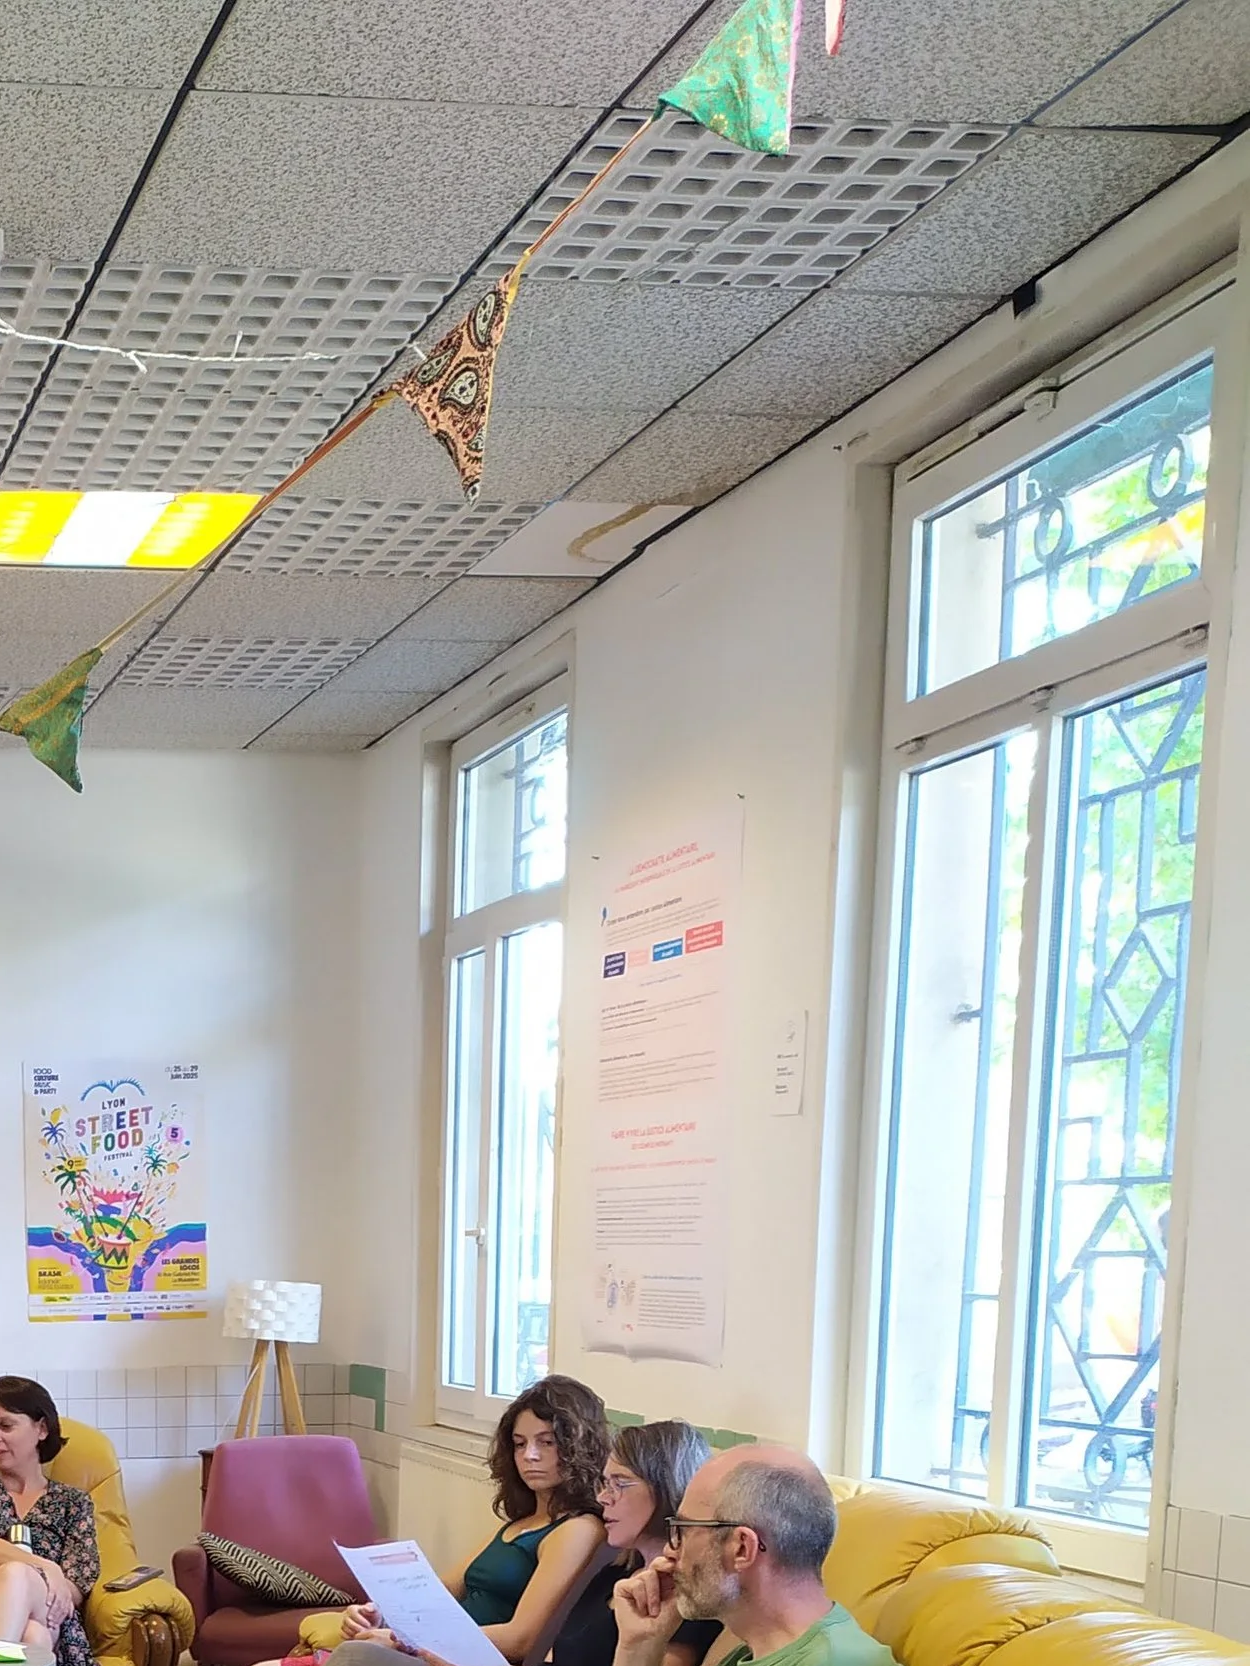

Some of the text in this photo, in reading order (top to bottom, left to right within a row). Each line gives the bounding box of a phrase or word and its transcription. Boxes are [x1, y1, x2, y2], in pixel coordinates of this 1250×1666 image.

[34, 1067, 53, 1075] FOOD
[101, 1097, 126, 1111] LYON
[75, 1106, 154, 1138] STREET
[170, 1127, 179, 1139] 5
[91, 1128, 144, 1155] FOOD
[103, 1150, 133, 1162] FESTIVAL
[66, 1159, 75, 1169] 9
